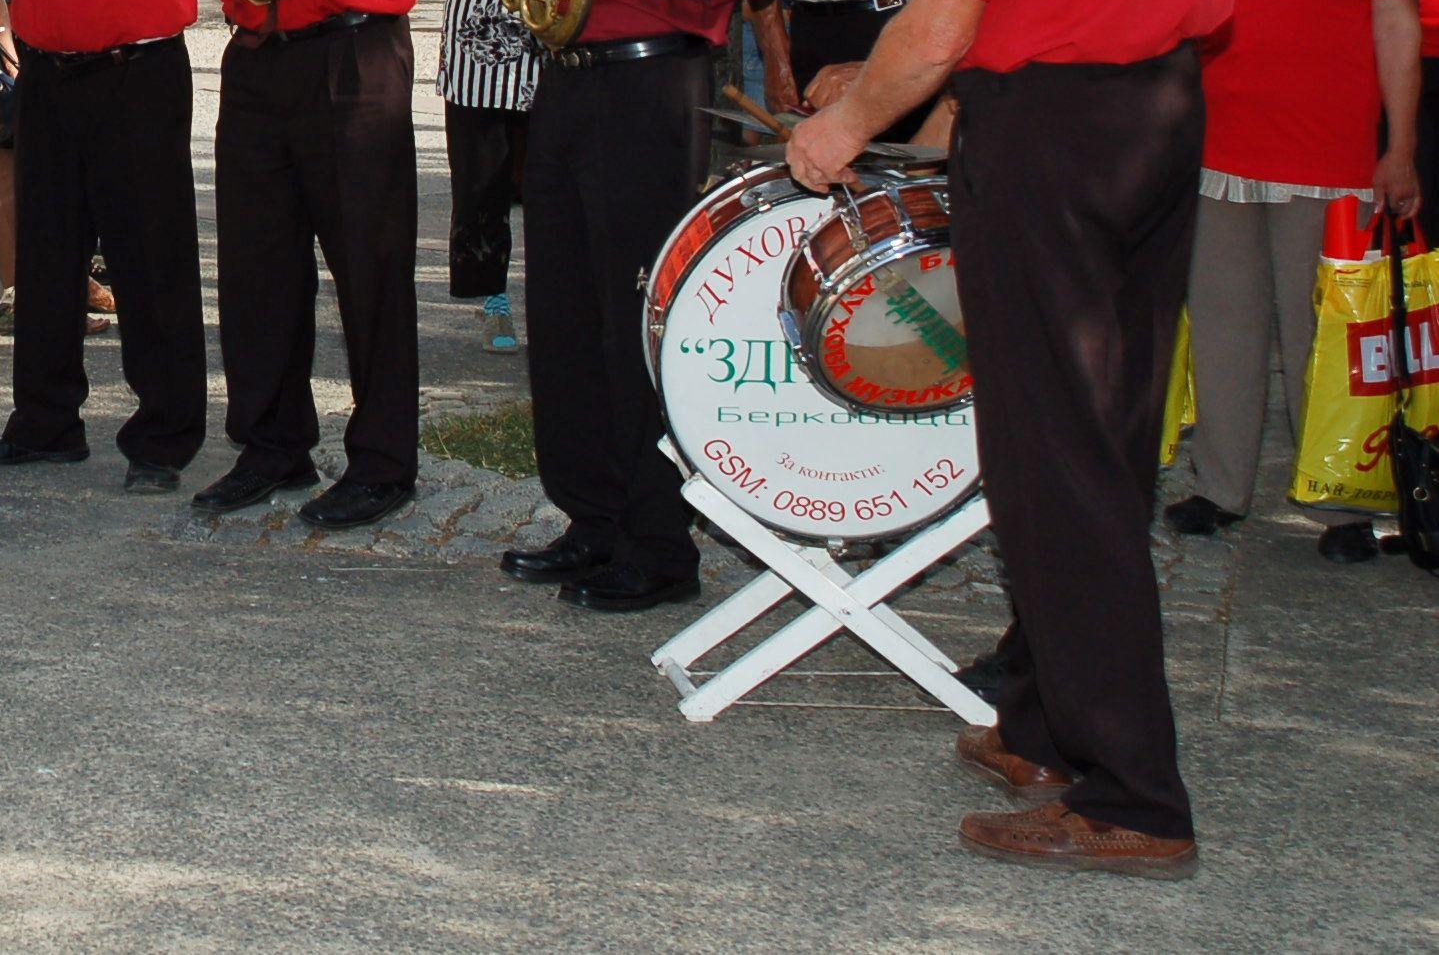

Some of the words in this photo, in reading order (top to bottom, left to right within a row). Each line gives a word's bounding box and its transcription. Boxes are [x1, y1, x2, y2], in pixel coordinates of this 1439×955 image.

[696, 213, 822, 326] ДУХОВ
[844, 374, 975, 405] МУЗИКА
[717, 406, 969, 427] Берковица
[776, 451, 795, 470] За
[703, 439, 768, 499] GSM:
[773, 490, 846, 523] 0889
[854, 489, 909, 520] 651
[912, 458, 965, 496] 152
